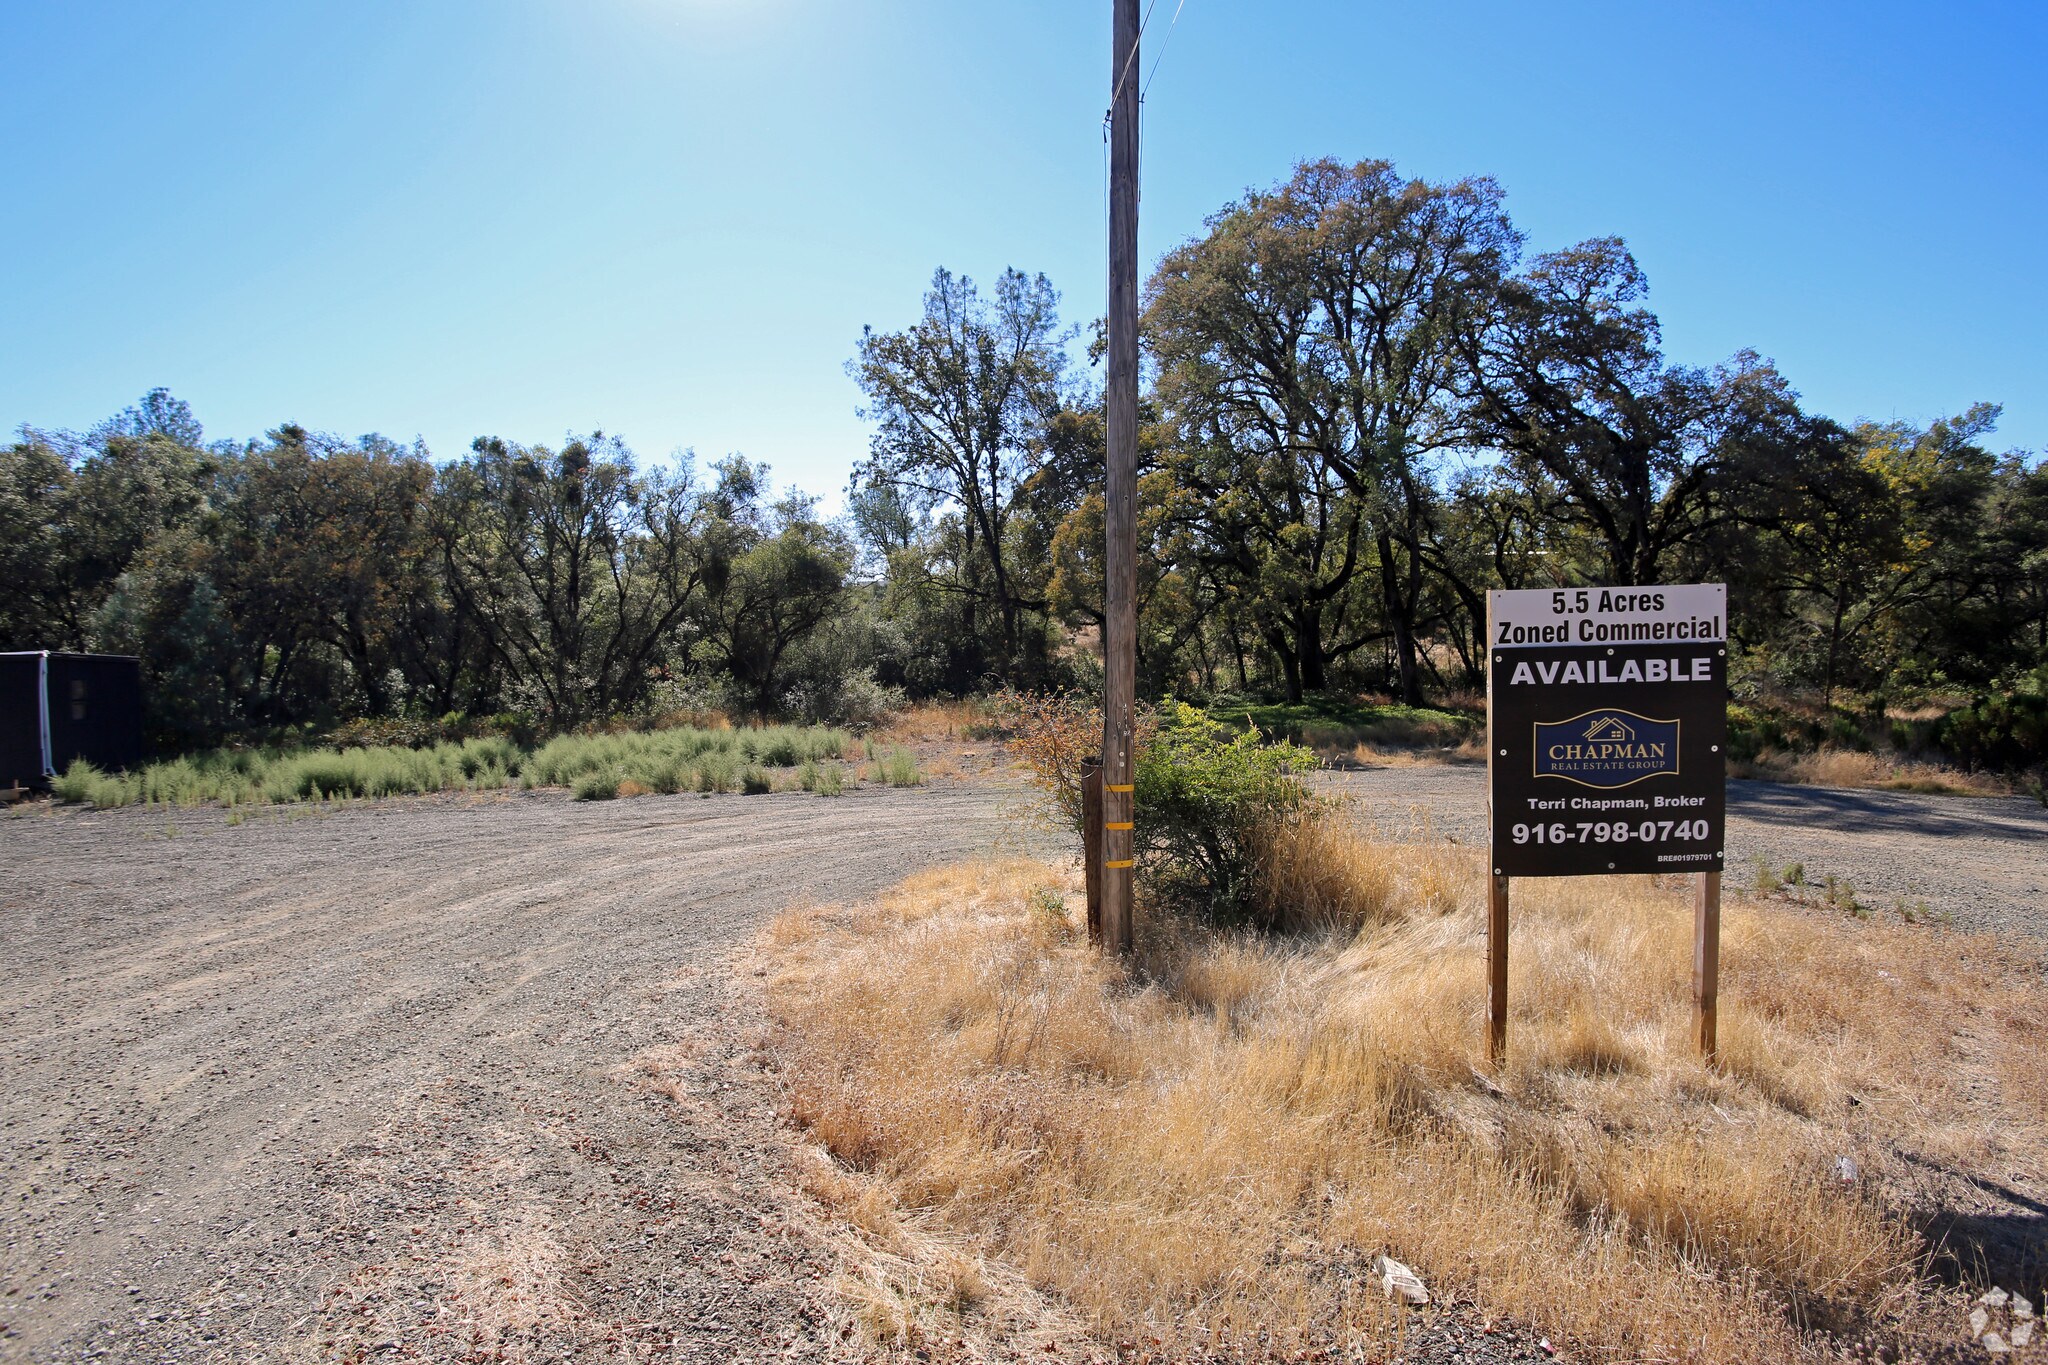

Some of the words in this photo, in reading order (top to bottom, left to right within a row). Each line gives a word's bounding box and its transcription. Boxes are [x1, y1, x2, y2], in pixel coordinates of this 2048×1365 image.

[1552, 591, 1588, 614] 5.5
[1598, 590, 1665, 612] Acres
[1498, 620, 1569, 644] Zoned
[1578, 616, 1720, 641] Commercial
[1510, 658, 1711, 685] AVAILABLE
[1549, 743, 1665, 760] CHAPMAN
[1583, 762, 1625, 770] ESTATE
[1628, 761, 1666, 769] GROUP
[1528, 798, 1565, 809] Terri
[1571, 797, 1649, 811] Chapman,
[1654, 796, 1705, 807] Broker
[1512, 820, 1709, 844] 916-798-0740
[1657, 854, 1712, 862] BRE#01979701
